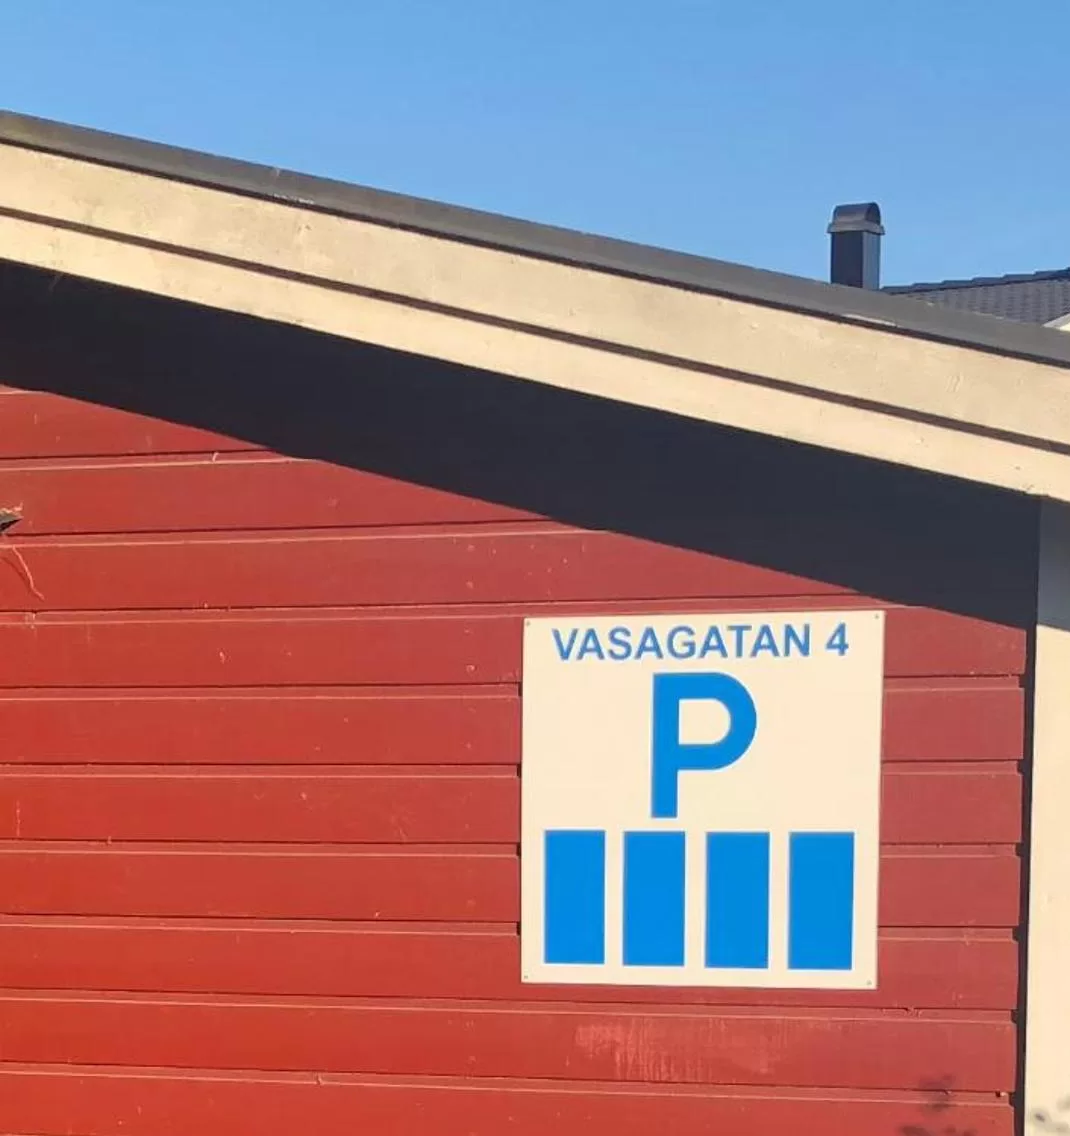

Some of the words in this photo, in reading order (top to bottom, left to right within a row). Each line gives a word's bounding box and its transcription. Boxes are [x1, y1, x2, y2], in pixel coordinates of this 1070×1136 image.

[552, 623, 811, 661] VASAGATAN
[826, 622, 849, 657] 4
[651, 672, 757, 819] P
